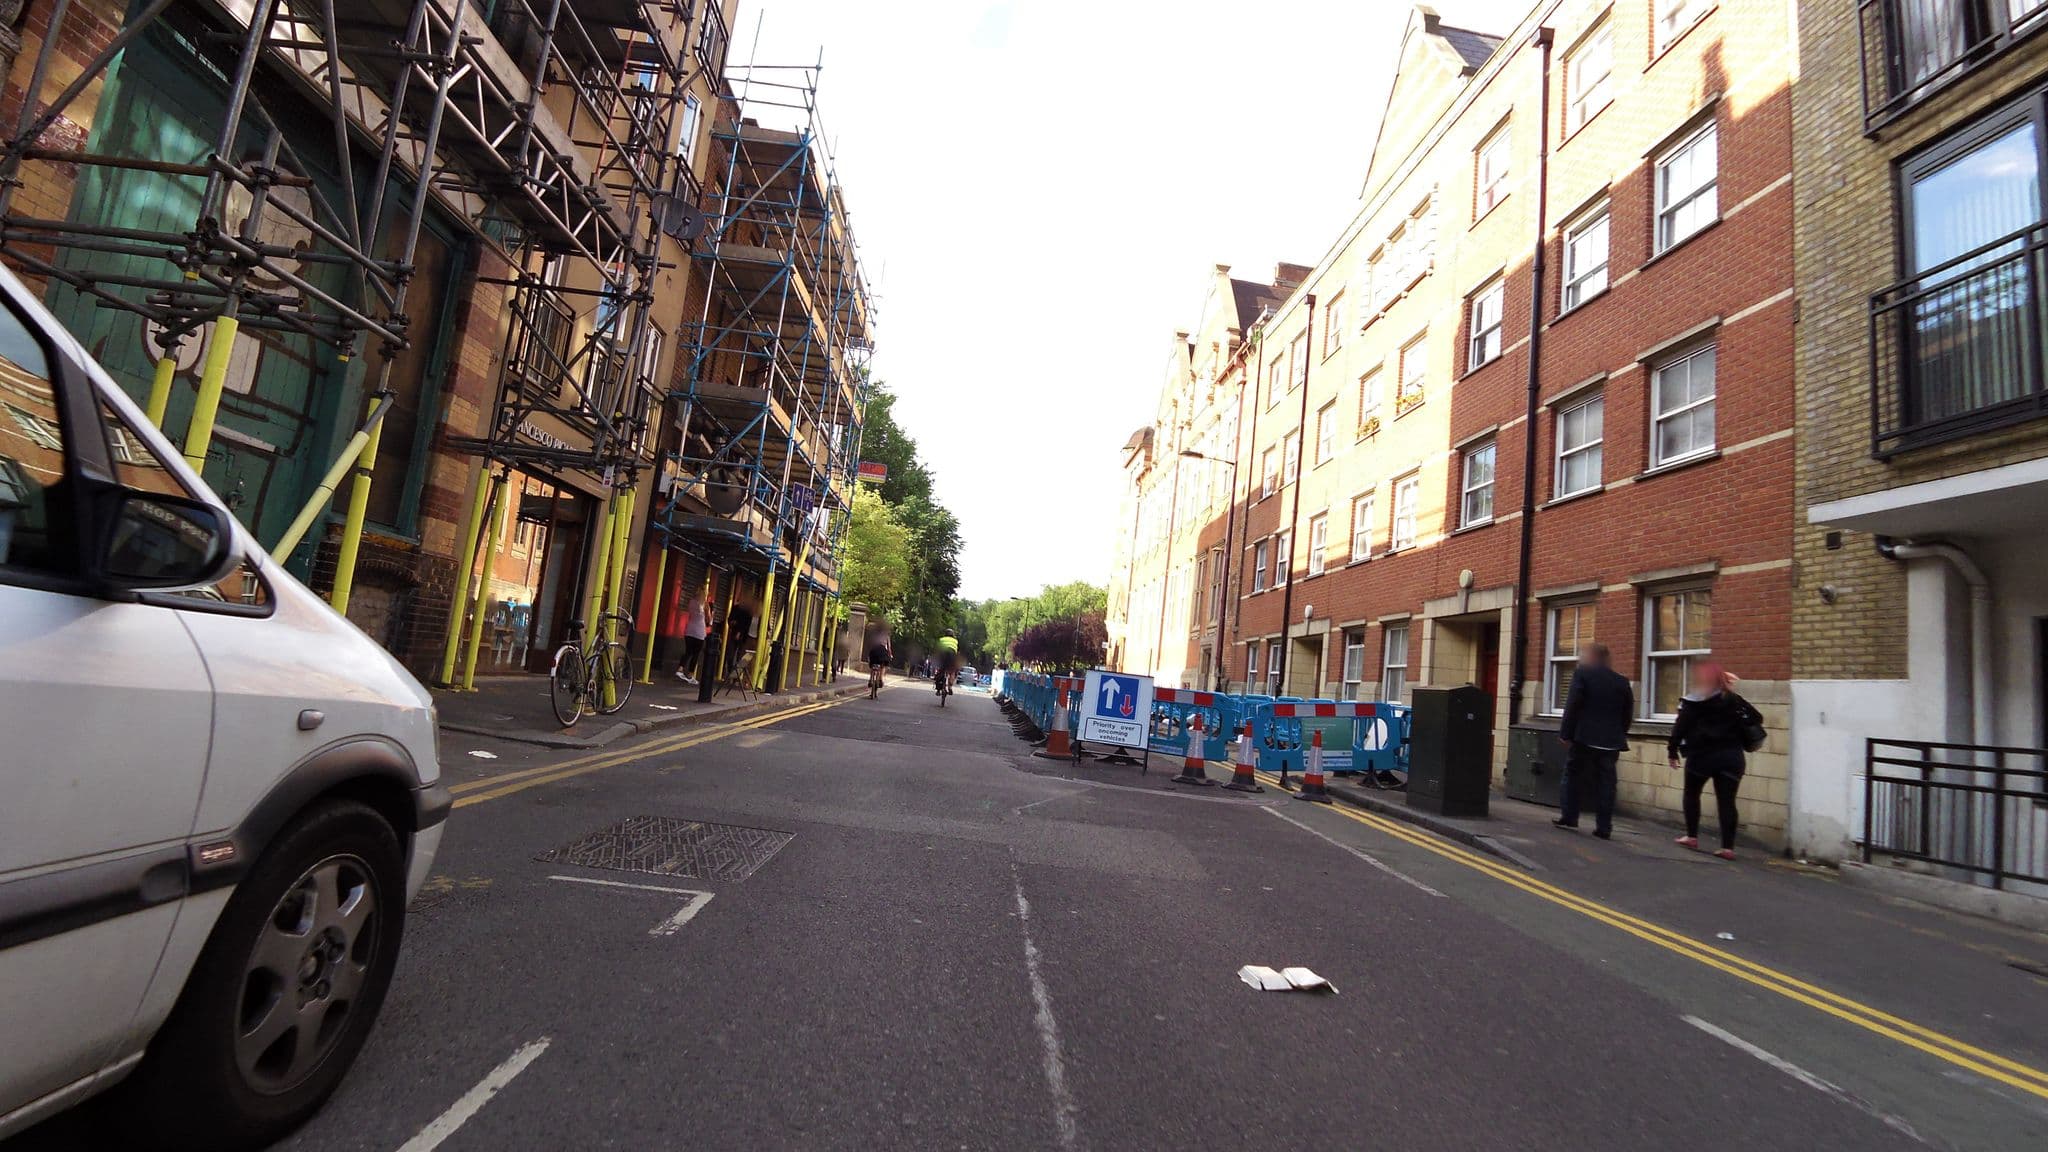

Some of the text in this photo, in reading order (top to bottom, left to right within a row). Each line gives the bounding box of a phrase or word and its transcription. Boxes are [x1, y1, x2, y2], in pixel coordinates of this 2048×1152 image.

[506, 411, 553, 448] FANCESCO
[1092, 720, 1115, 730] Priority
[1098, 729, 1129, 738] oncoming
